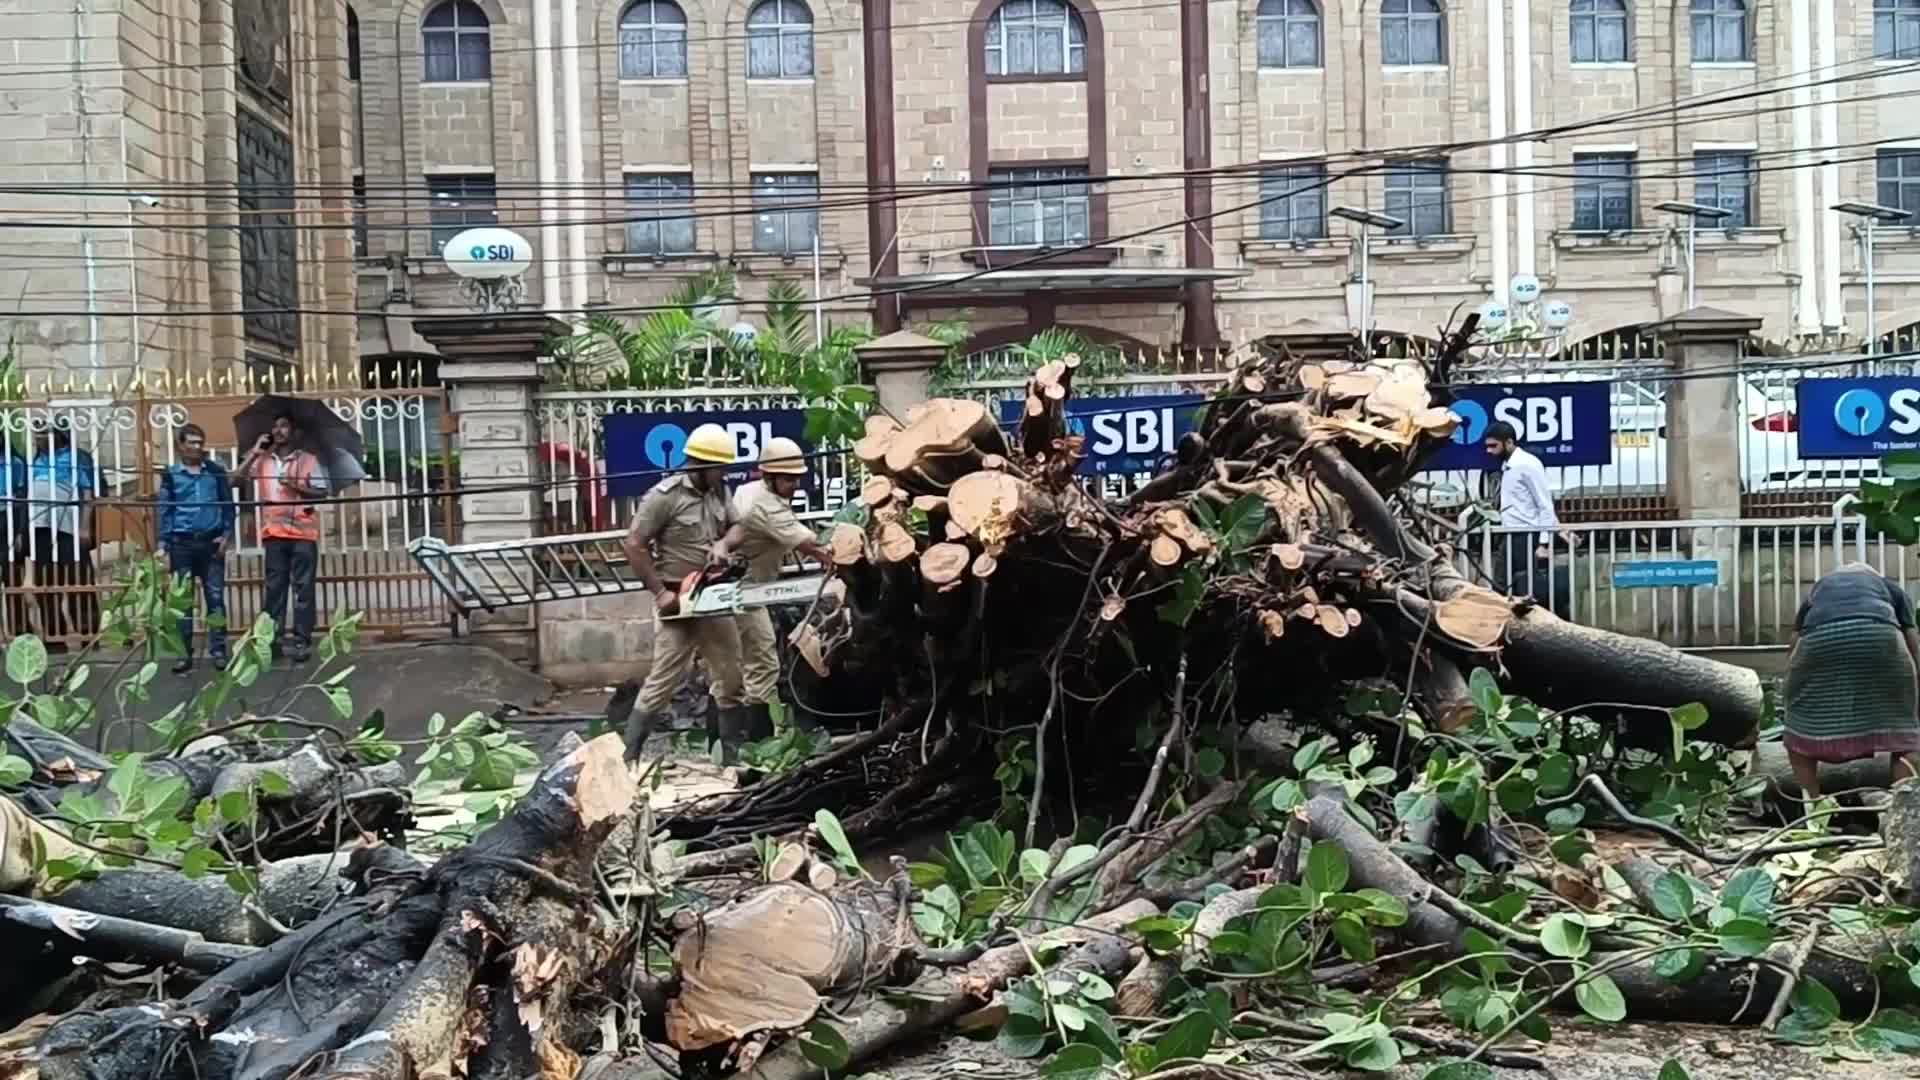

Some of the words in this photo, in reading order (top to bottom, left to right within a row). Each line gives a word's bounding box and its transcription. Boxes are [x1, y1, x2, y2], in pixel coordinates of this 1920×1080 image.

[487, 244, 514, 260] SBI
[1091, 407, 1174, 456] SBI
[1494, 396, 1573, 442] SBI
[725, 421, 773, 463] BI
